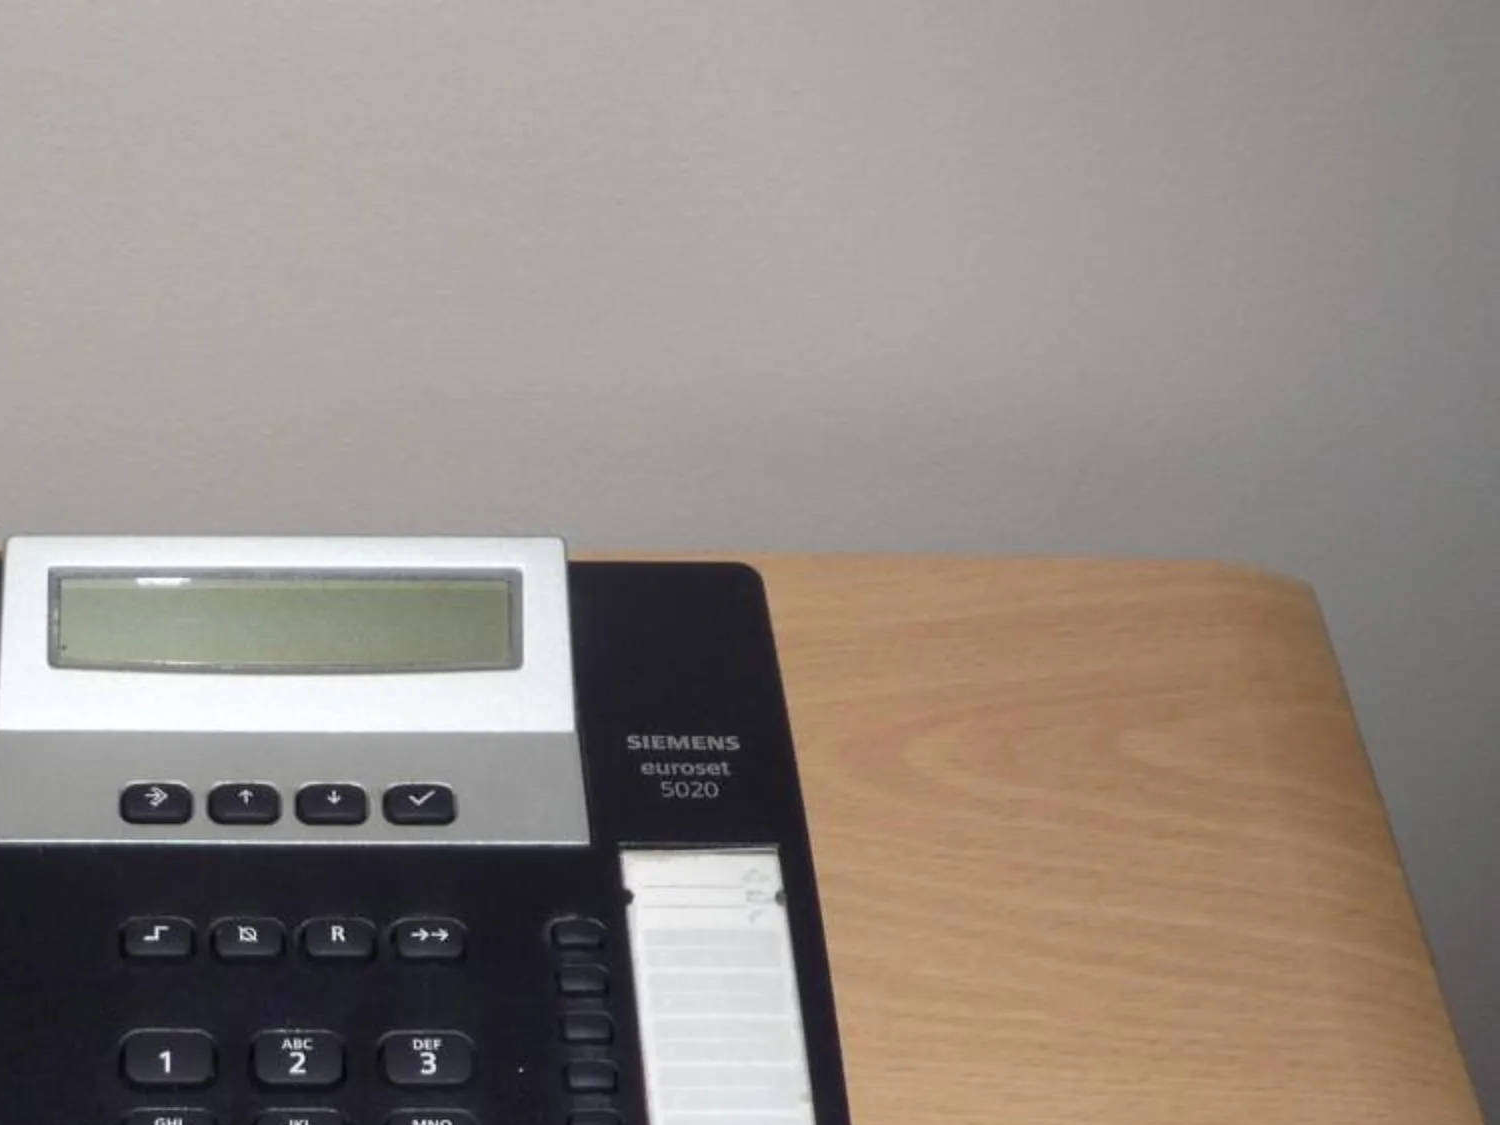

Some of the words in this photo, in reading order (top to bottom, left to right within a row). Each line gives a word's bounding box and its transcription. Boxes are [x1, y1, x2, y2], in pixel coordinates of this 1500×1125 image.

[626, 734, 741, 751] SIEMENS
[640, 761, 731, 777] euroset
[660, 780, 720, 799] 5020
[331, 925, 346, 942] R
[281, 1038, 313, 1051] ABC
[412, 1038, 441, 1051] DEF
[159, 1050, 171, 1074] 1
[289, 1052, 307, 1075] 2
[420, 1052, 437, 1075] 3
